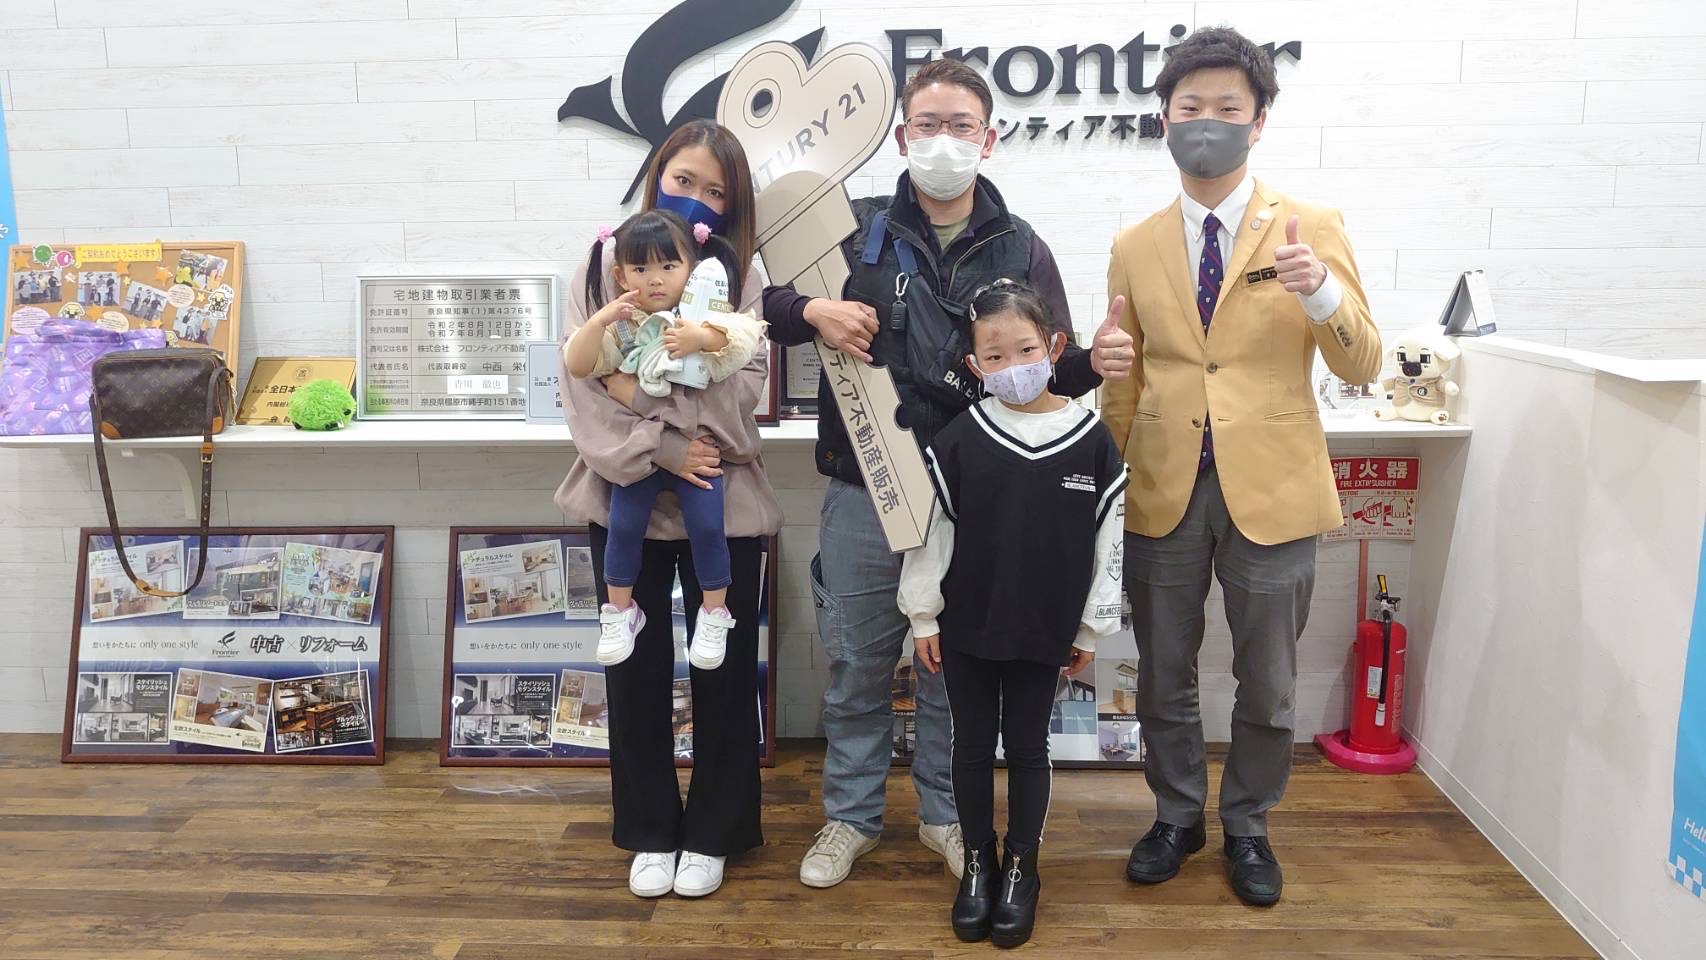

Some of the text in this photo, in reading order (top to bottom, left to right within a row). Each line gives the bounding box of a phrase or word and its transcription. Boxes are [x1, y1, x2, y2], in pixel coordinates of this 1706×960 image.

[838, 83, 866, 120] 21
[393, 288, 521, 301] 宅地建物取引業者票
[482, 361, 502, 372] 中西
[1333, 458, 1408, 480] 消火器
[1340, 480, 1352, 488] FIRE
[140, 640, 158, 650] only
[179, 640, 199, 650] style
[469, 642, 517, 650] 想いをかたちに
[520, 641, 540, 651] only
[562, 641, 583, 651] style
